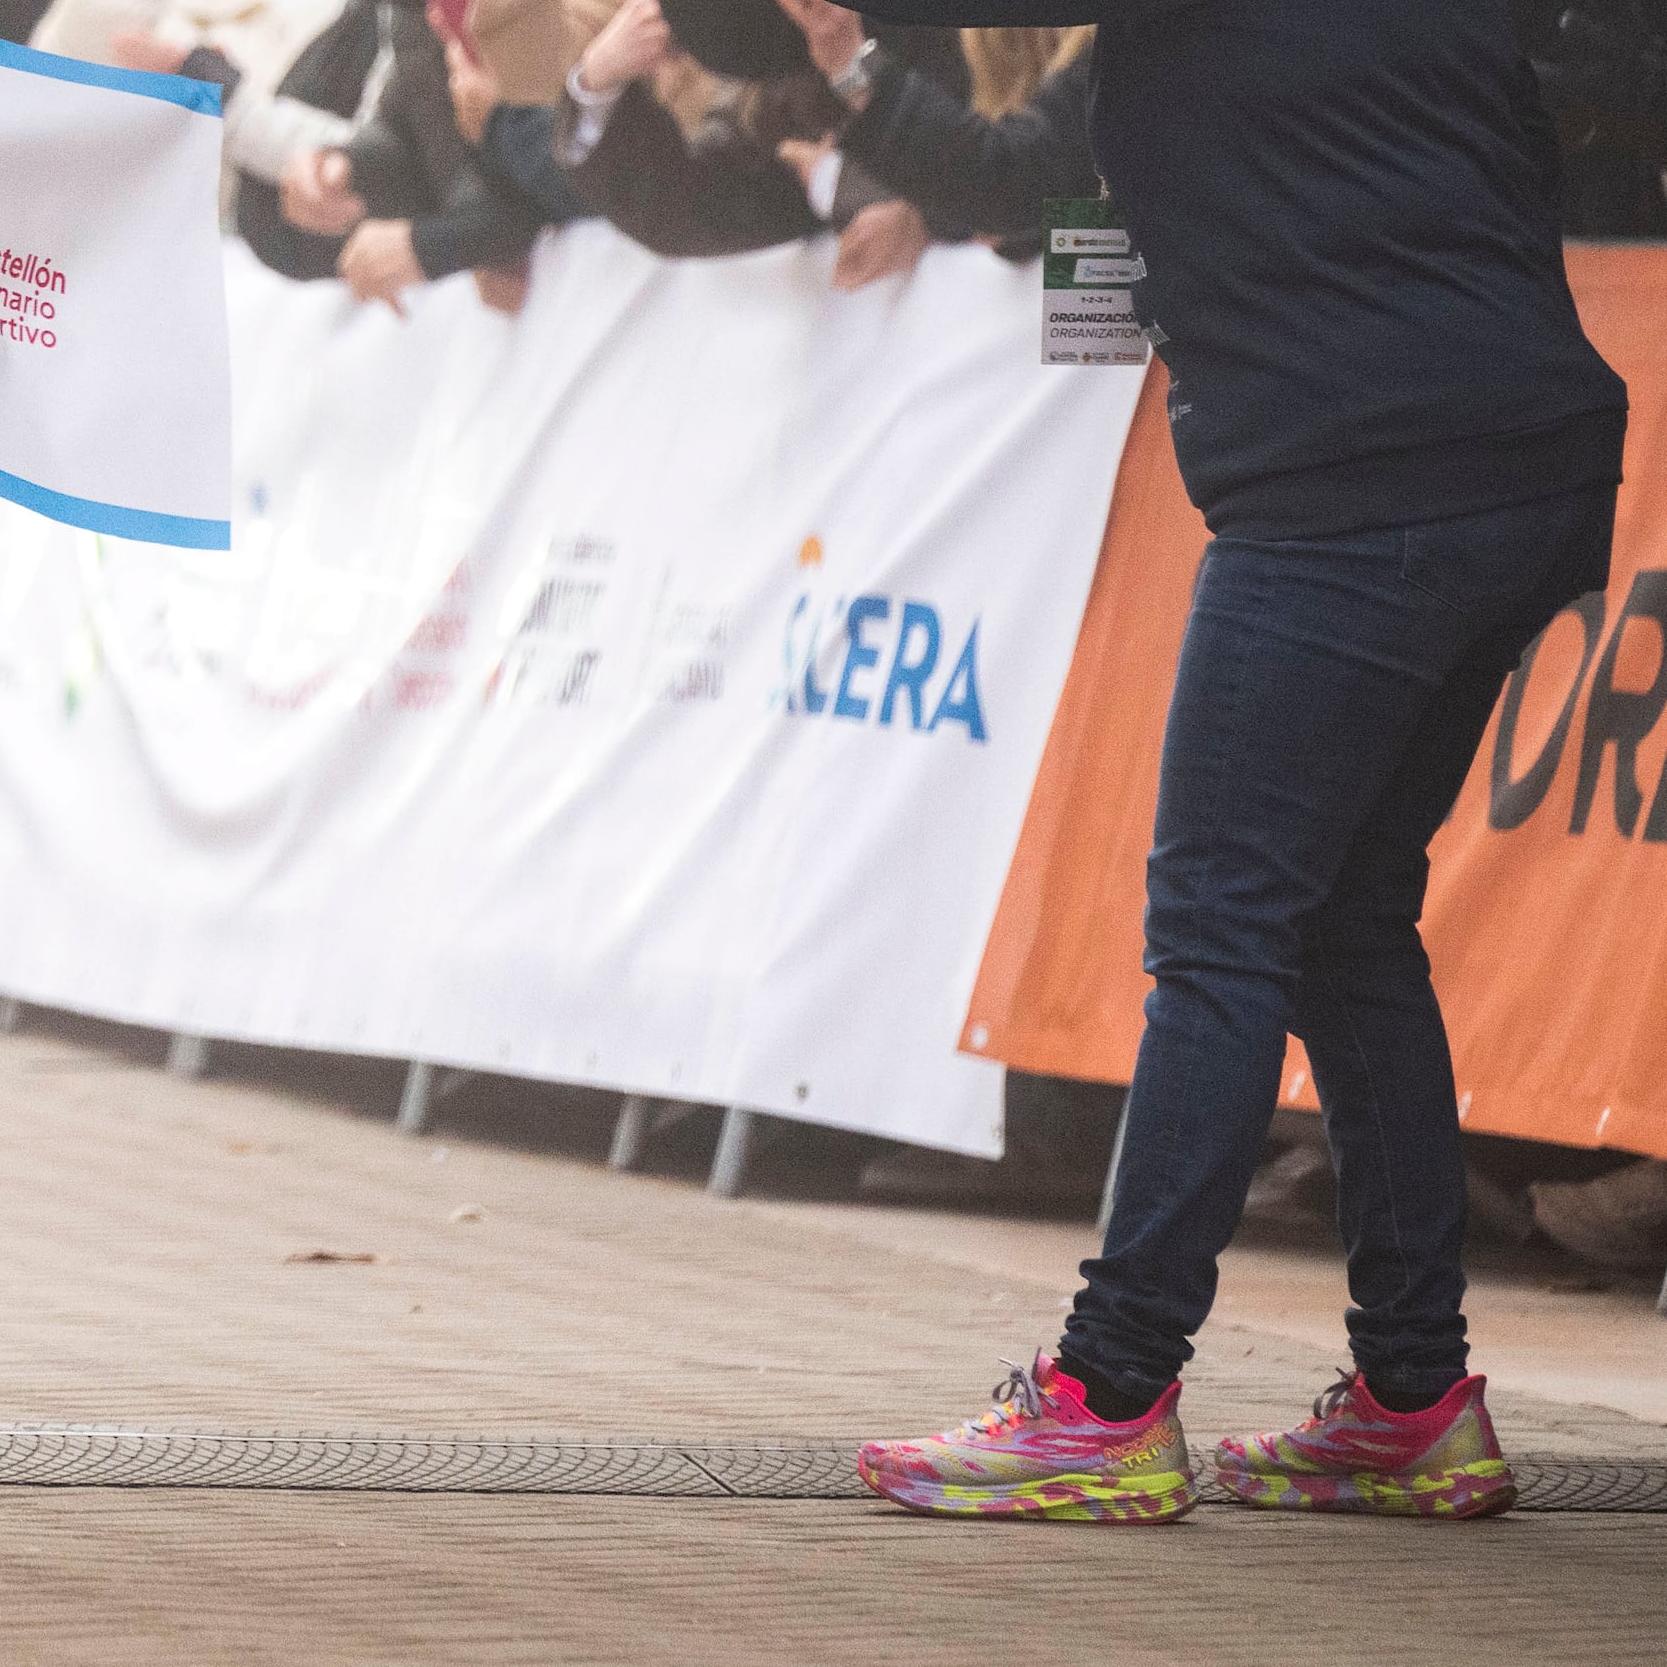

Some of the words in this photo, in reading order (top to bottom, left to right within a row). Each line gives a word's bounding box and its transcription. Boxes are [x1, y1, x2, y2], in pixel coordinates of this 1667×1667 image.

[1049, 310, 1137, 323] ORGANIZACIÓ
[1050, 327, 1142, 339] ORGANIZATION
[1121, 1446, 1159, 1469] TRI
